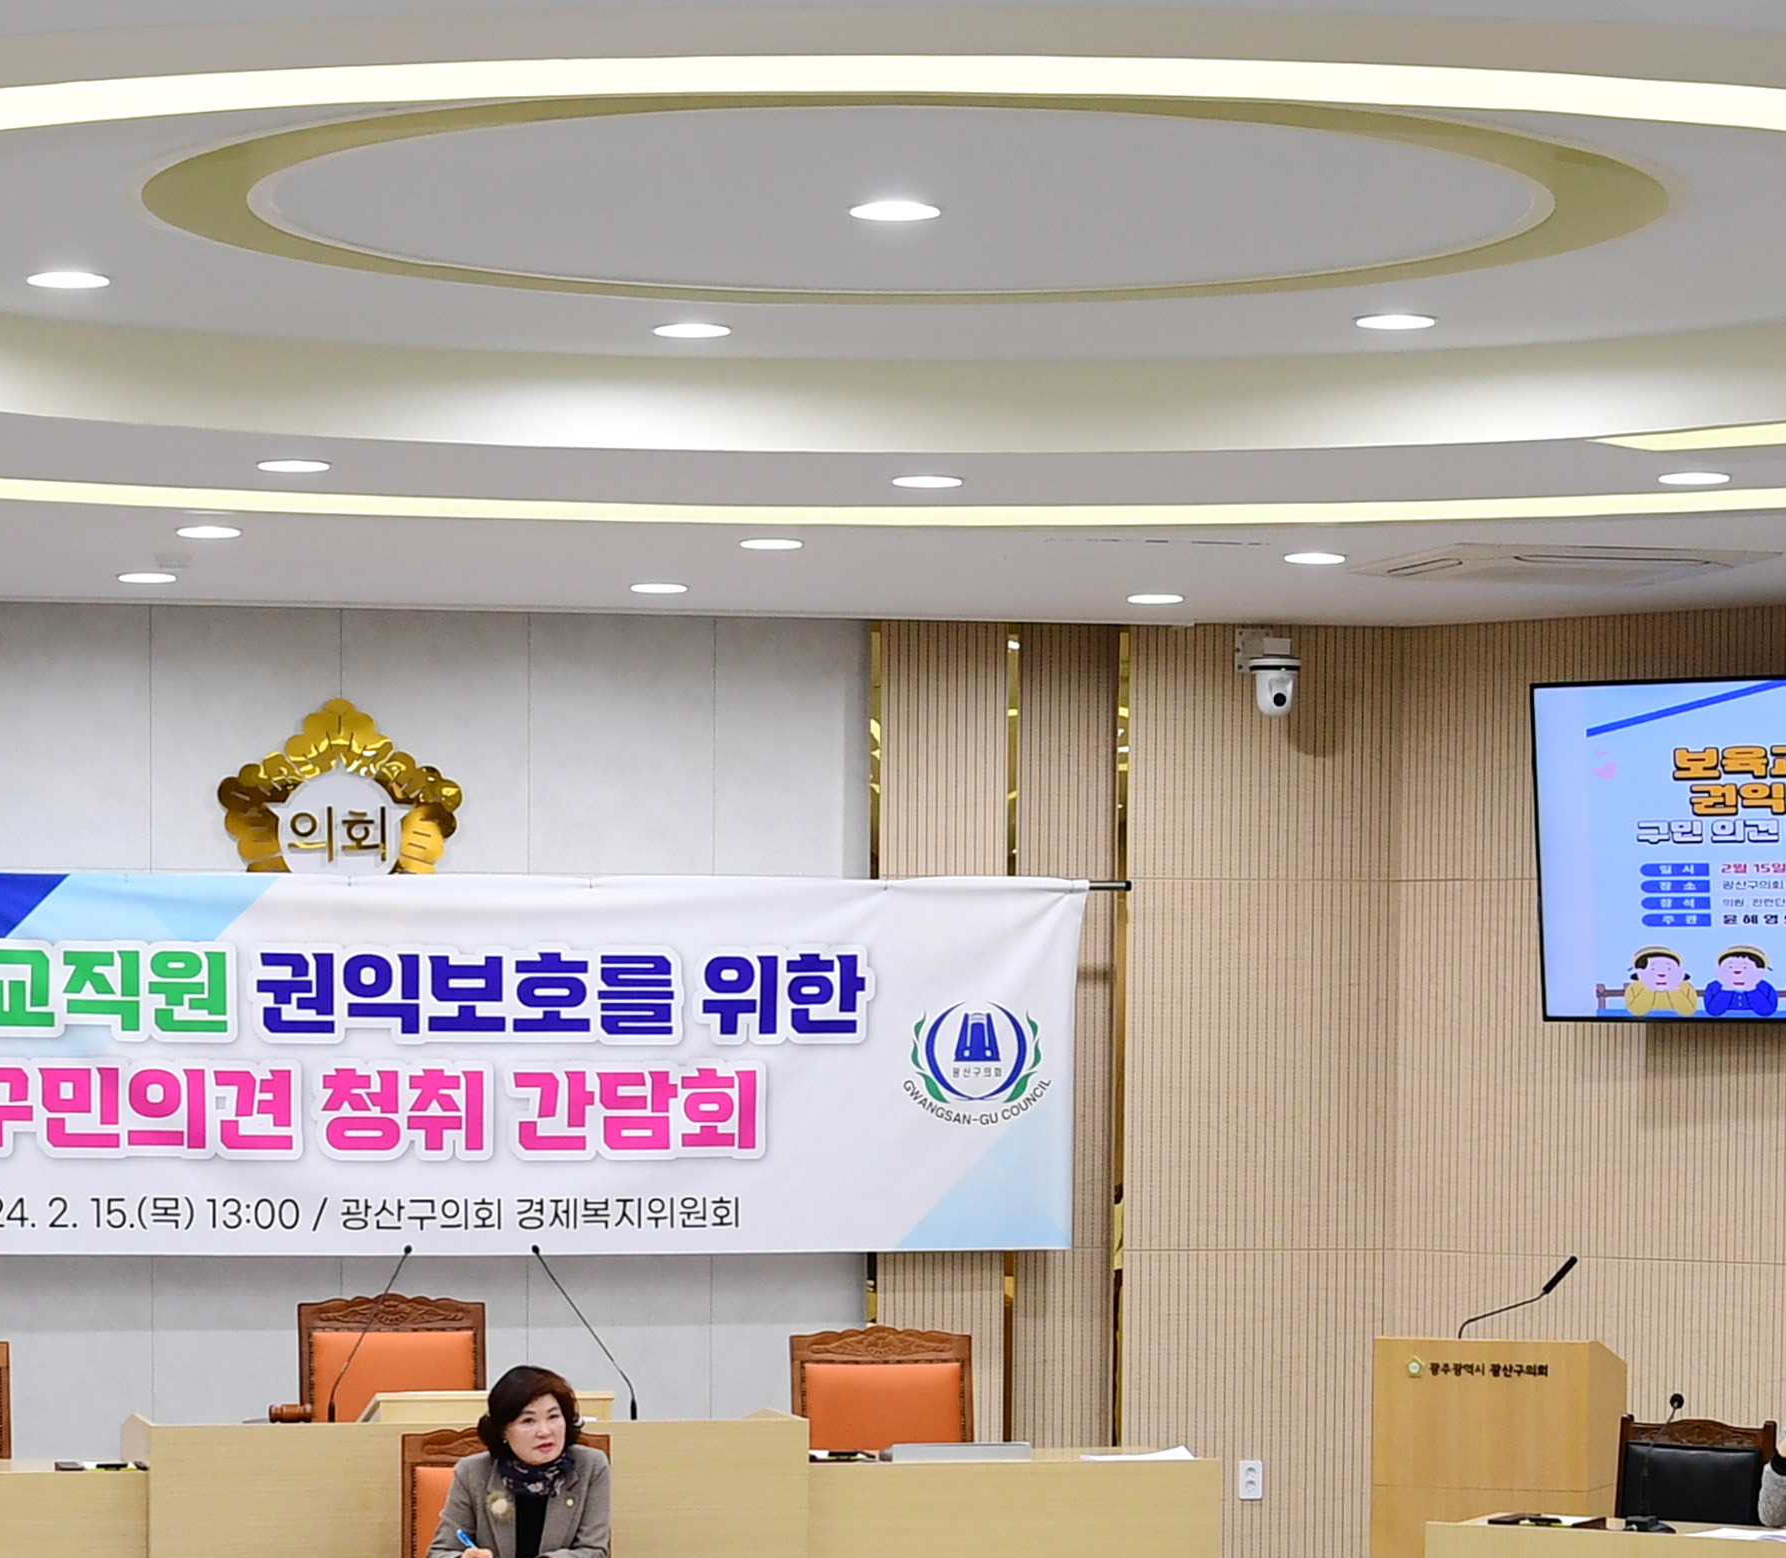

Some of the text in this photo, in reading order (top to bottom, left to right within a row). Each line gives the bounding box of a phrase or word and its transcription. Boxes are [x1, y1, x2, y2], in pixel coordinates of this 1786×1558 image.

[288, 806, 386, 862] 의회
[1637, 820, 1703, 843] 구민
[256, 952, 675, 1036] 권익보호를
[702, 953, 866, 1036] 위한
[322, 1068, 484, 1152] 청취
[512, 1068, 757, 1152] 간담회
[903, 1077, 1052, 1125] GWANGSAN-GU COUNCIL
[48, 1197, 78, 1228] 2.
[91, 1196, 195, 1230] 15.(목)
[207, 1197, 300, 1229] 13:00
[312, 1197, 328, 1231] /
[340, 1197, 502, 1230] 광산구의회
[516, 1196, 740, 1229] 경제복지위원회
[1429, 1362, 1548, 1377] 광주광역시 광산구의회
